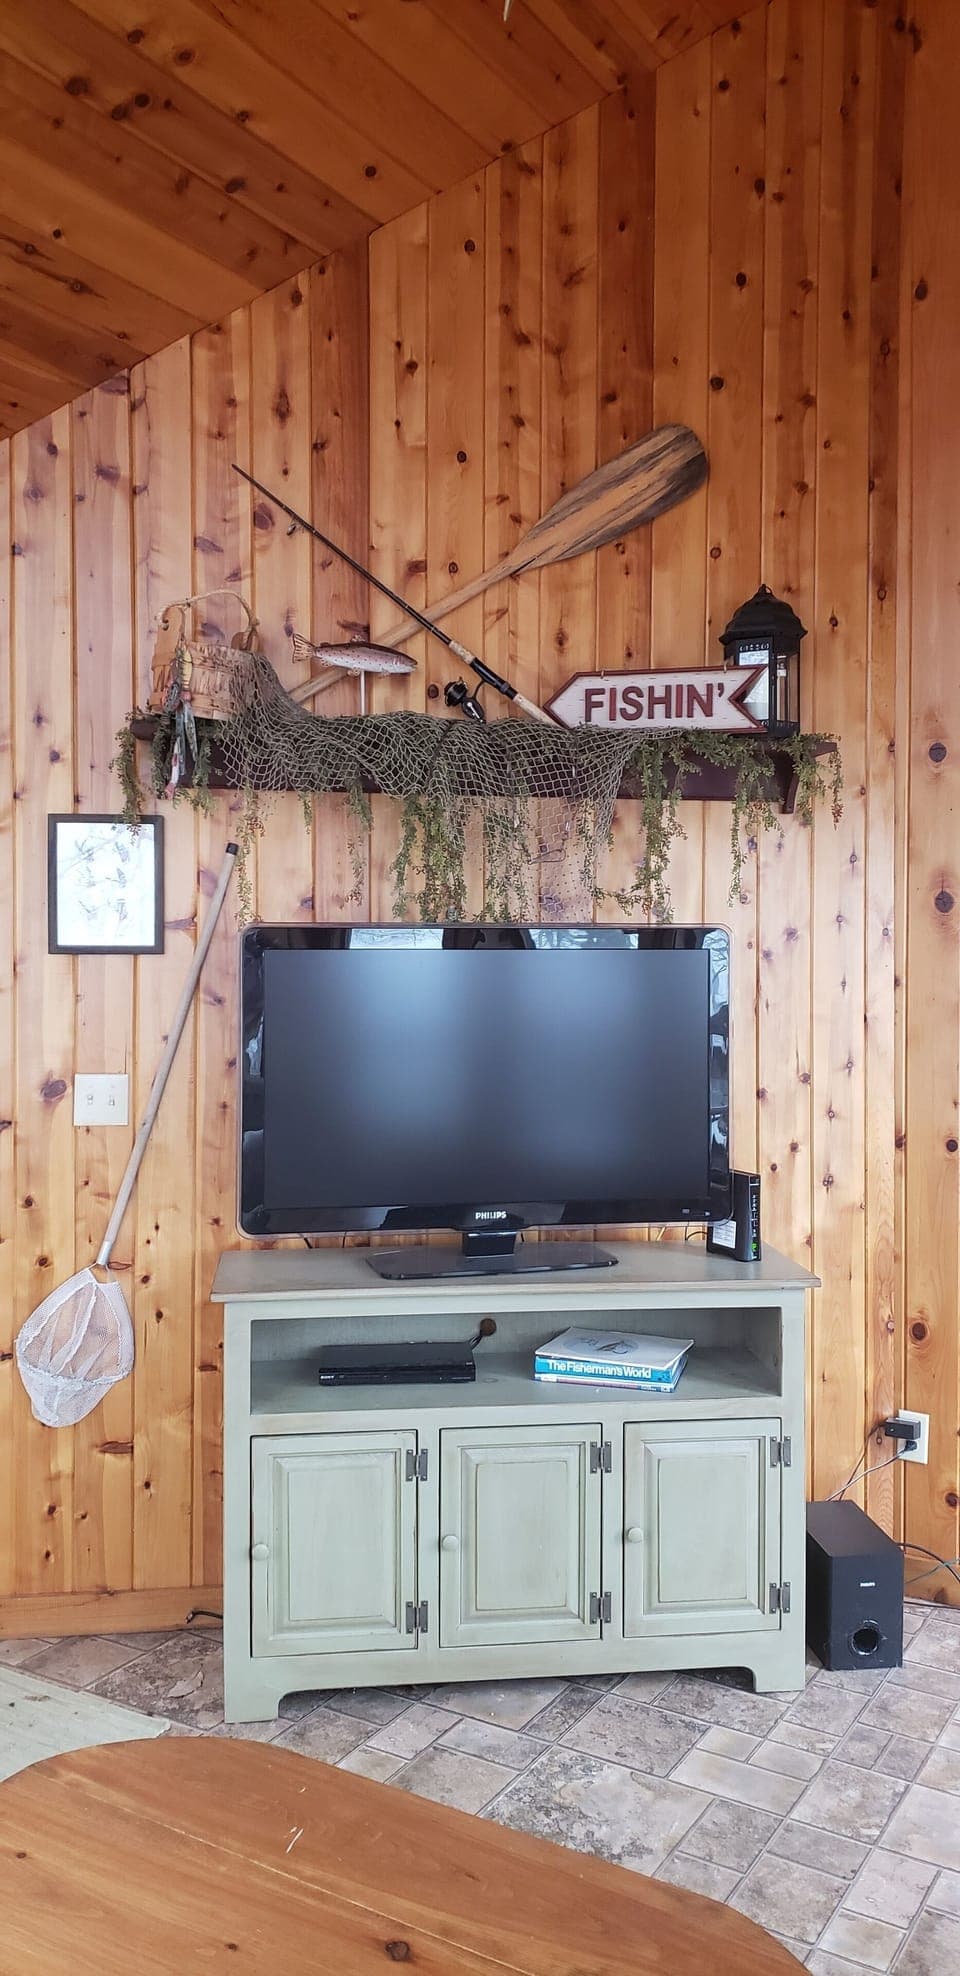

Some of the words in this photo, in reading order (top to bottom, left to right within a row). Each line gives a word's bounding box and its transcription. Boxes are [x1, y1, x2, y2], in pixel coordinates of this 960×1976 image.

[584, 682, 725, 723] FISHIN'
[475, 1211, 507, 1220] PHILIPS
[548, 1360, 566, 1371] The
[566, 1361, 623, 1376] Fisherman's
[623, 1367, 652, 1379] World
